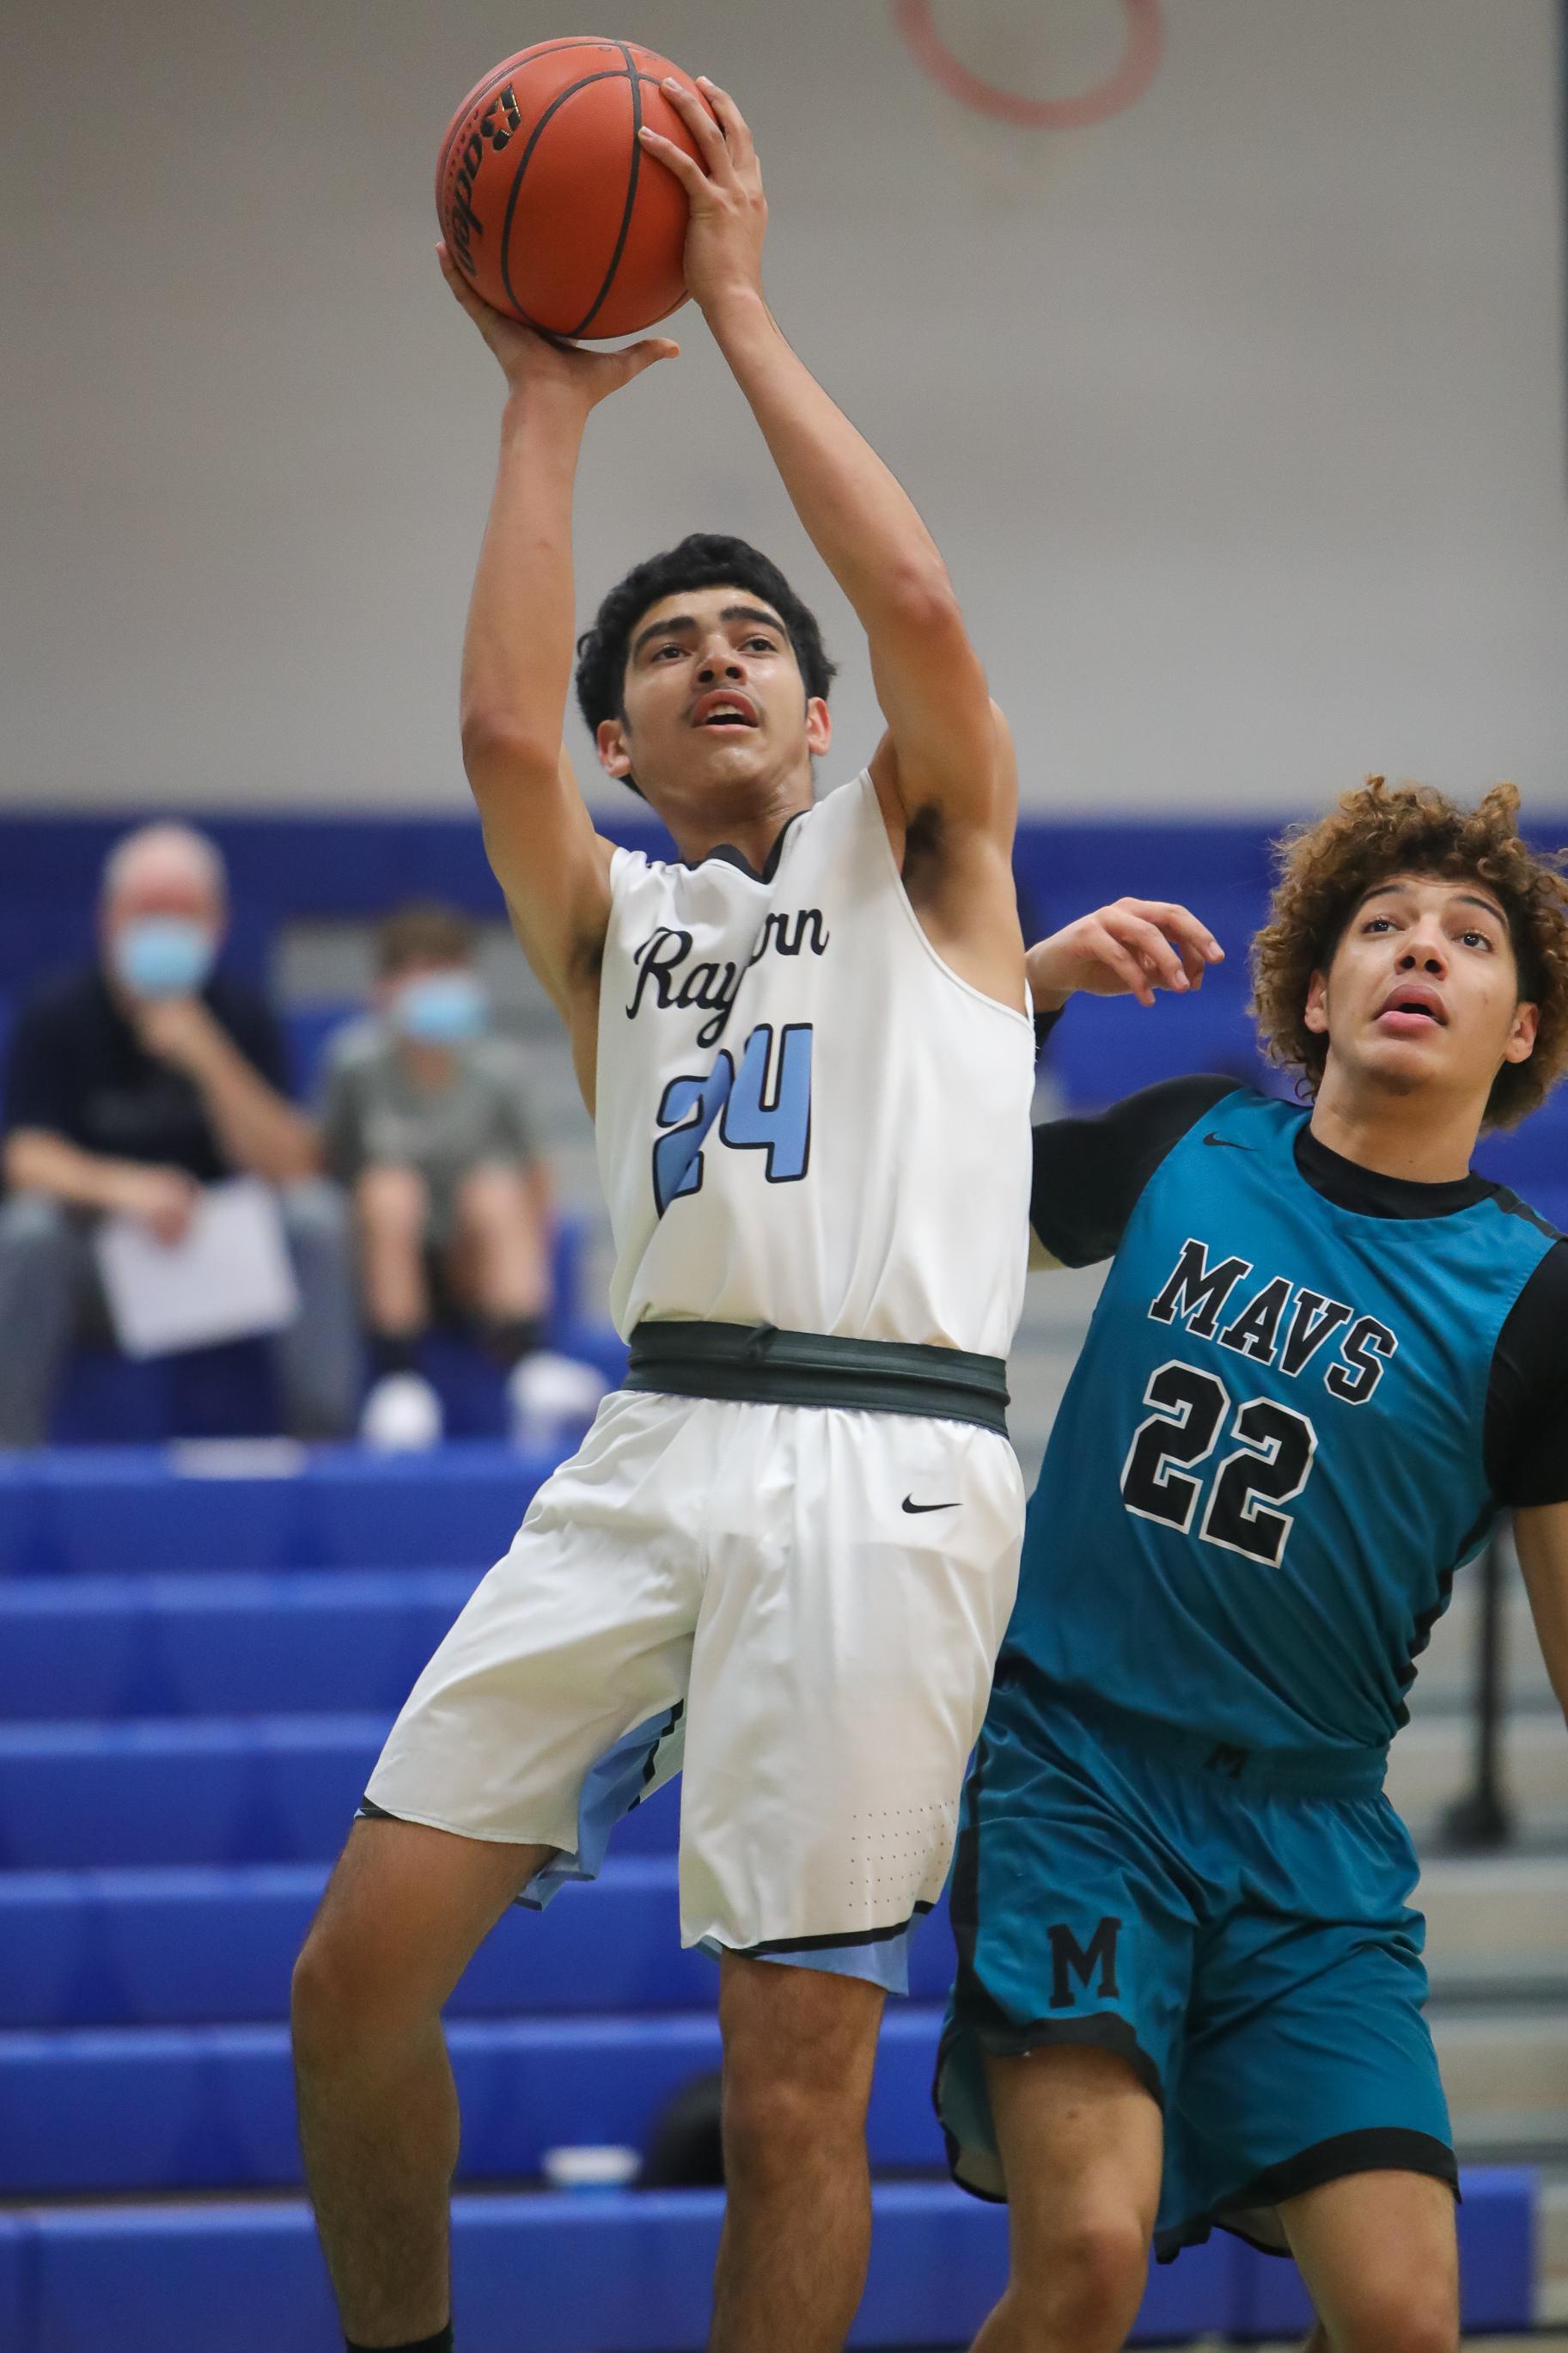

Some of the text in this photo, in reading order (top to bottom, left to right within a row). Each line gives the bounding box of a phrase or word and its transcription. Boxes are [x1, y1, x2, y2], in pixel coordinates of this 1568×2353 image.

[625, 908, 830, 1049] Rayrn
[652, 1023, 813, 1219] 24
[1147, 1237, 1399, 1406] MAVS
[1120, 1359, 1319, 1569] 22
[1046, 1916, 1122, 2009] M
